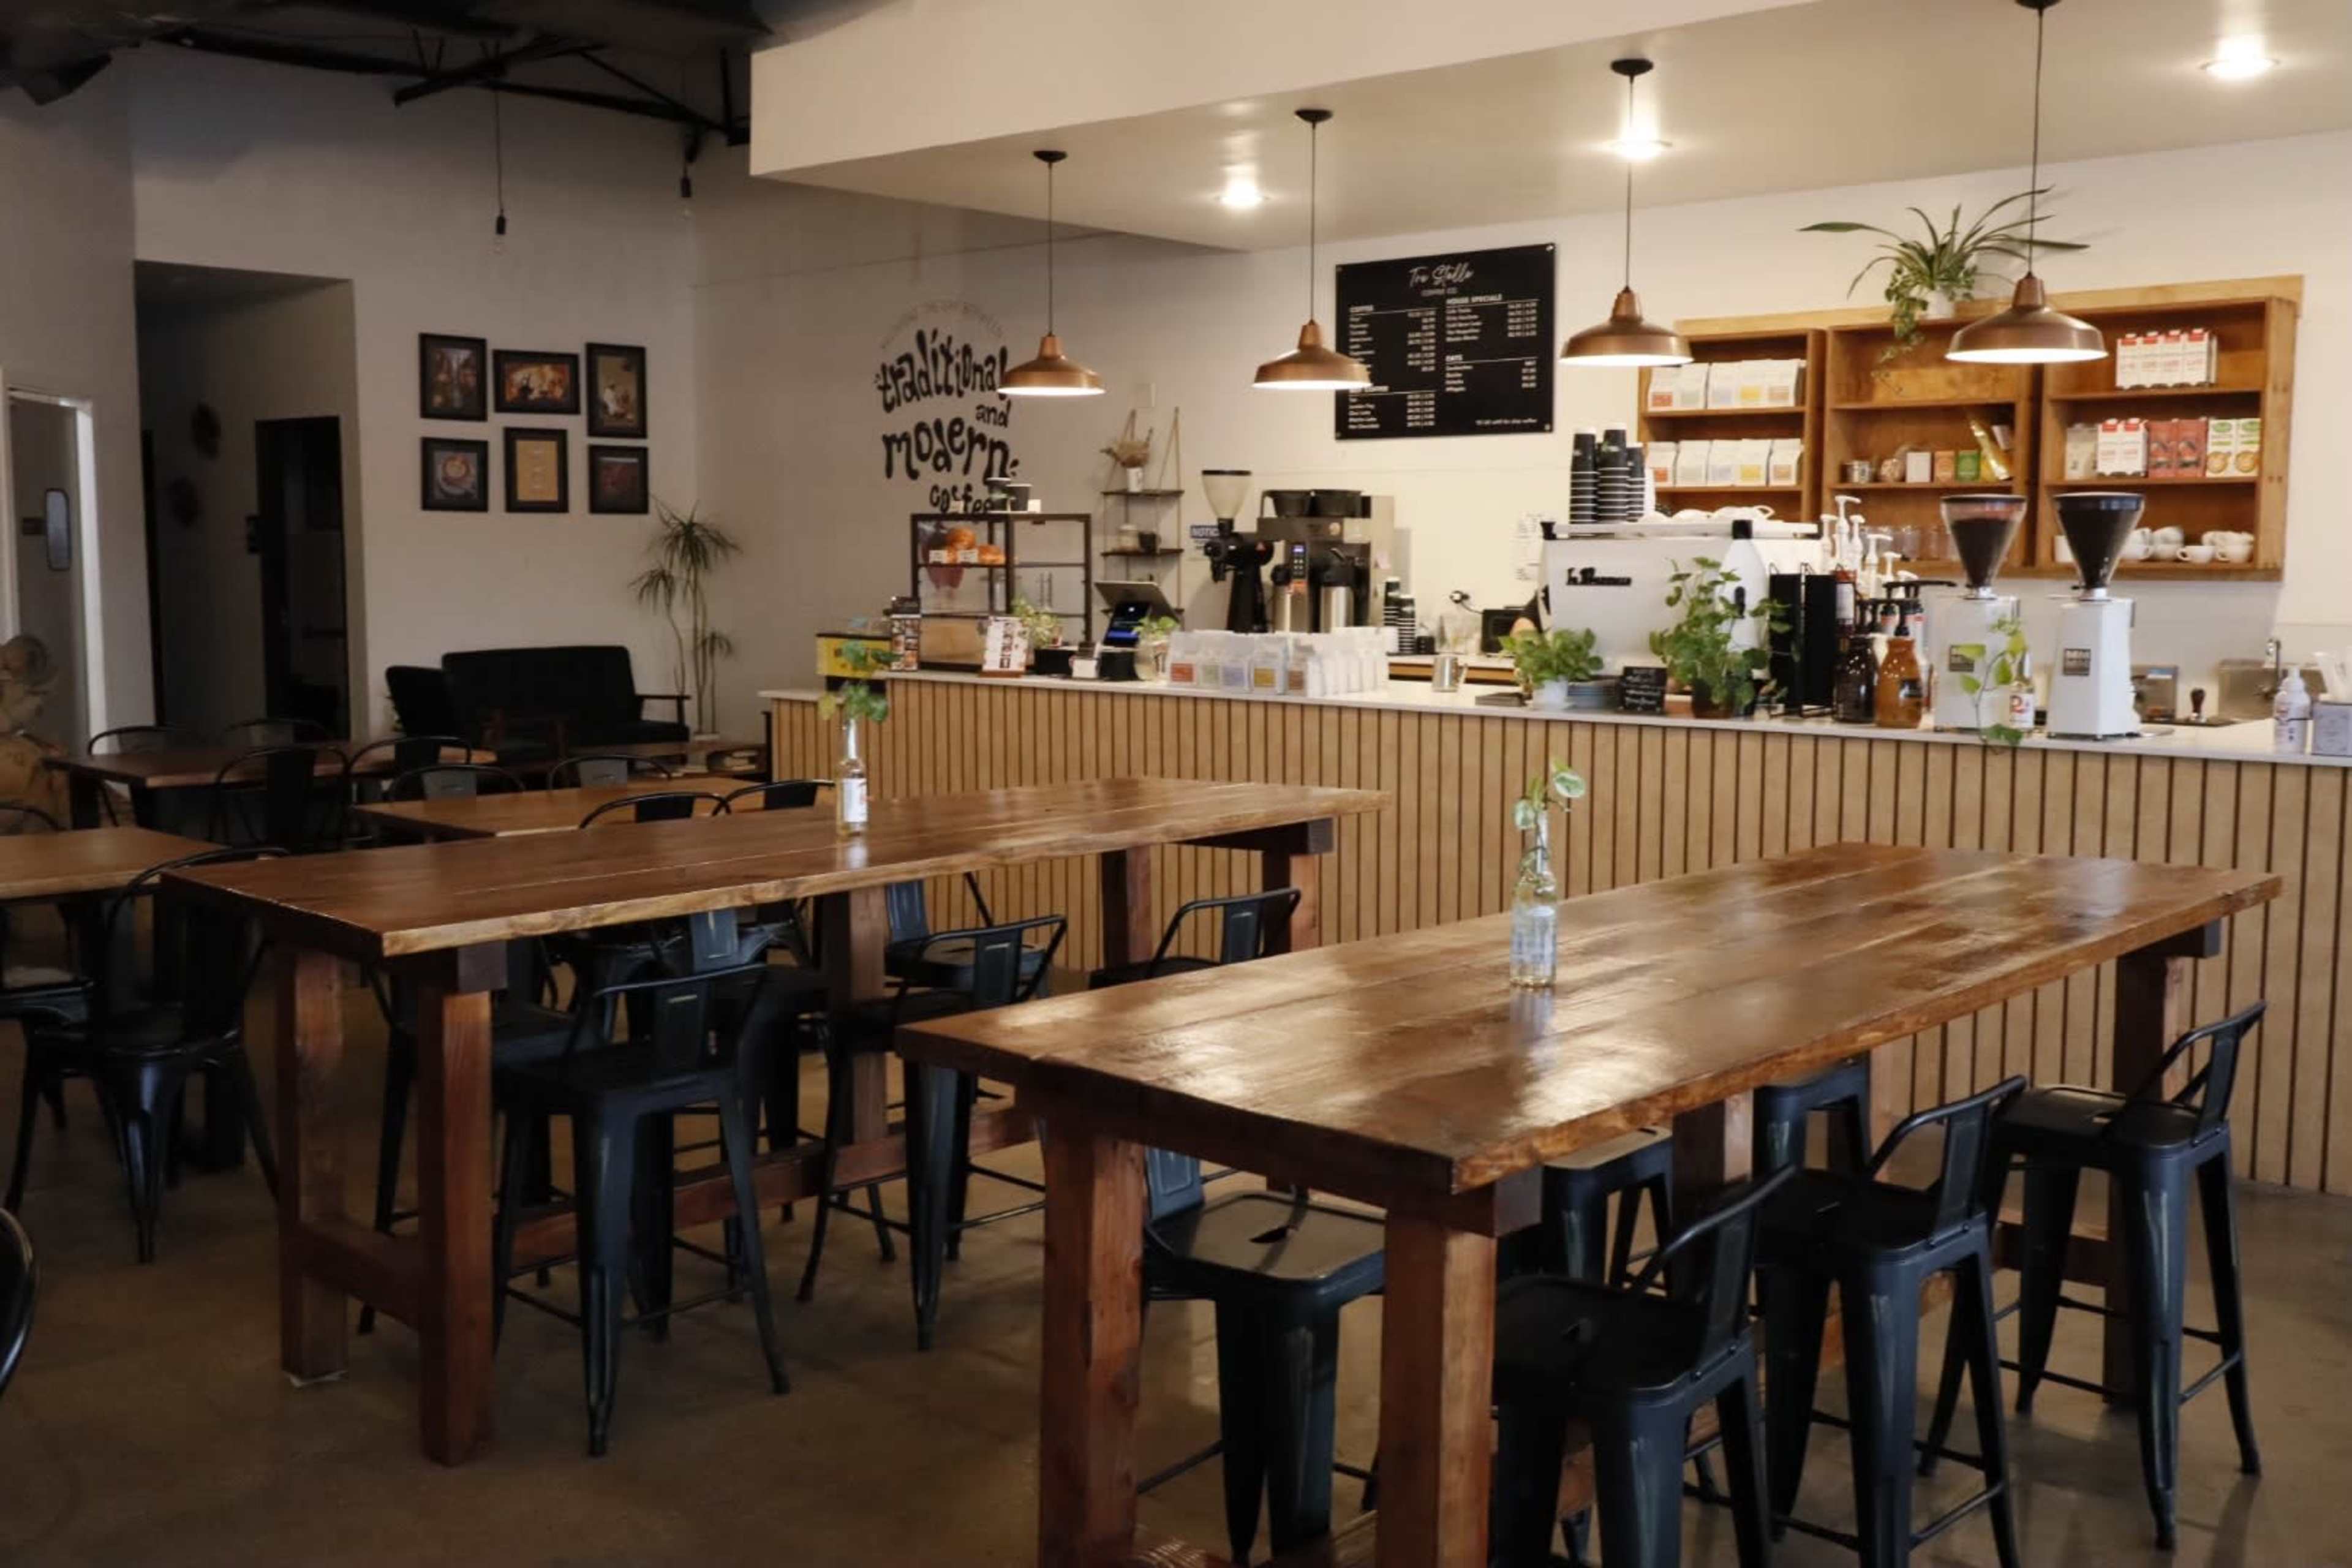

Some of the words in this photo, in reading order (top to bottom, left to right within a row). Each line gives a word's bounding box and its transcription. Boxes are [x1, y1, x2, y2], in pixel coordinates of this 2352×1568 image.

[876, 328, 1008, 413] traditional
[975, 398, 1011, 429] and
[882, 418, 1011, 486] modern
